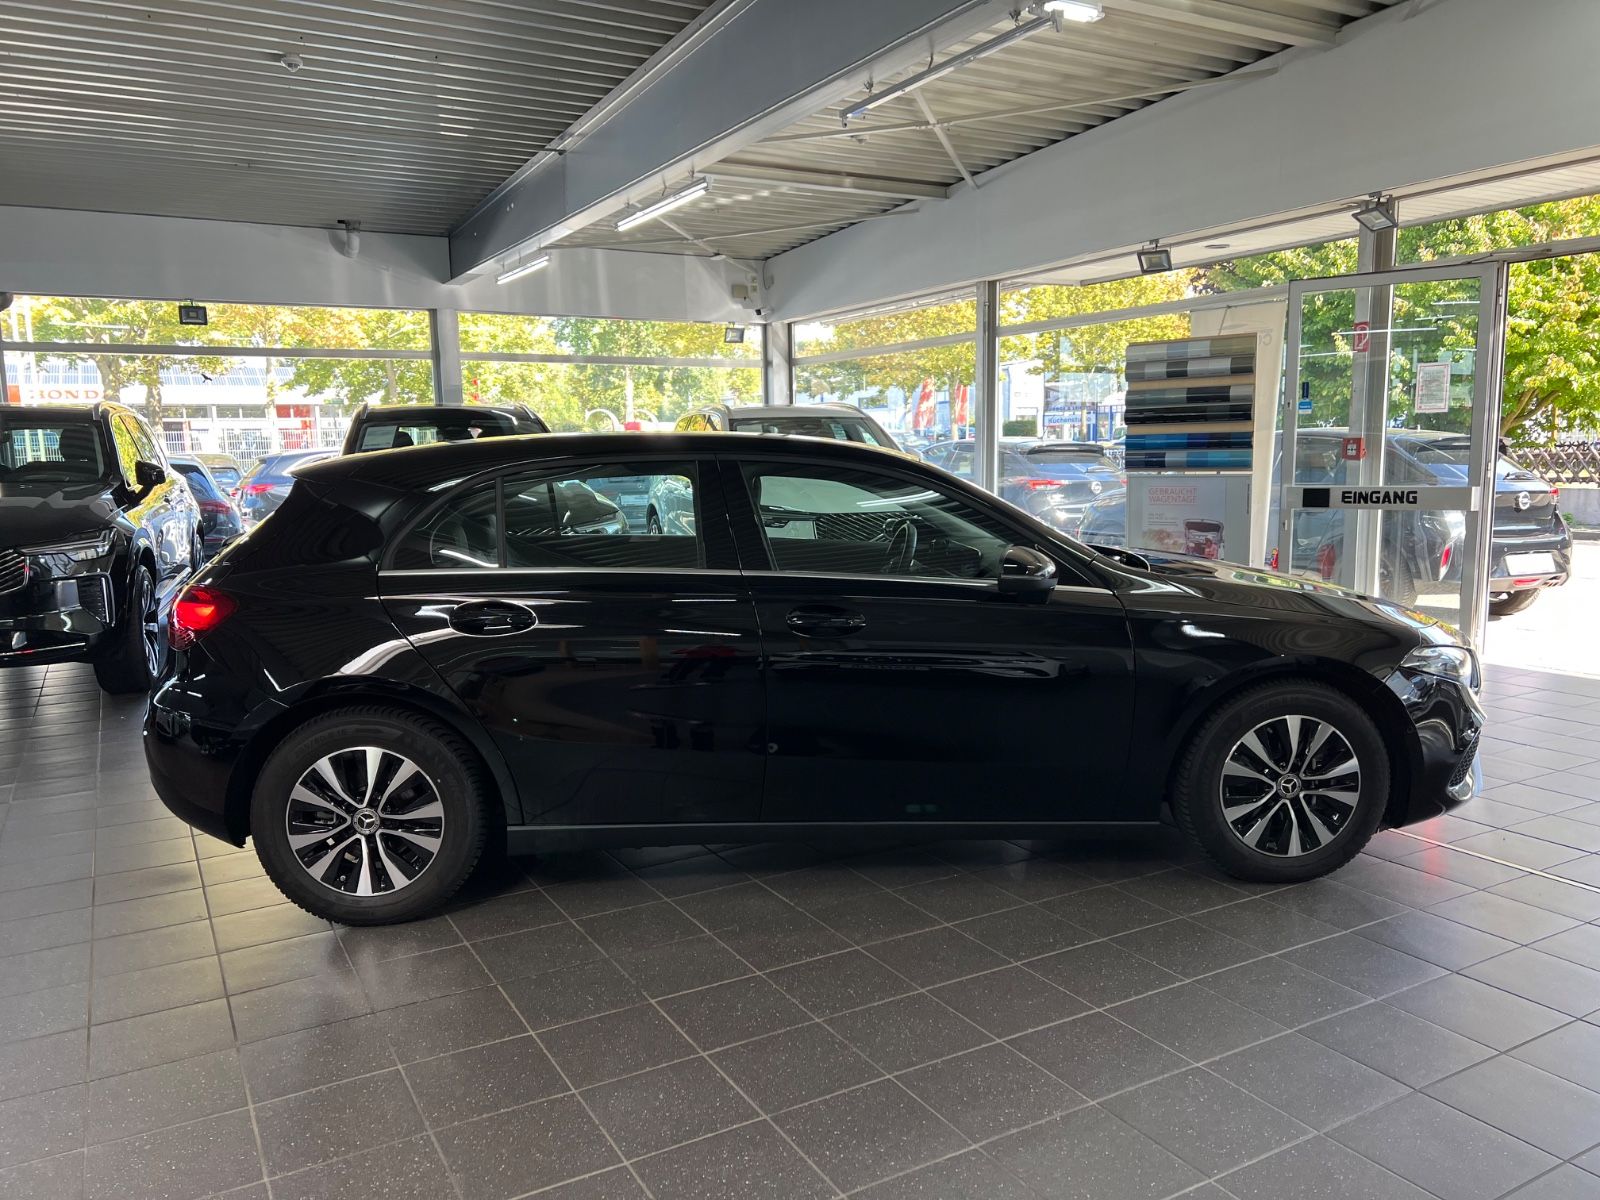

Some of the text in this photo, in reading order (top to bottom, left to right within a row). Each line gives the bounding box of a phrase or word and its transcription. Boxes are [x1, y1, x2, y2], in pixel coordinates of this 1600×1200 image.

[29, 389, 100, 400] HOND
[1148, 487, 1198, 496] GEBRAUCHT
[1148, 495, 1198, 504] WAGENTAGE
[1341, 490, 1418, 505] EINGANG
